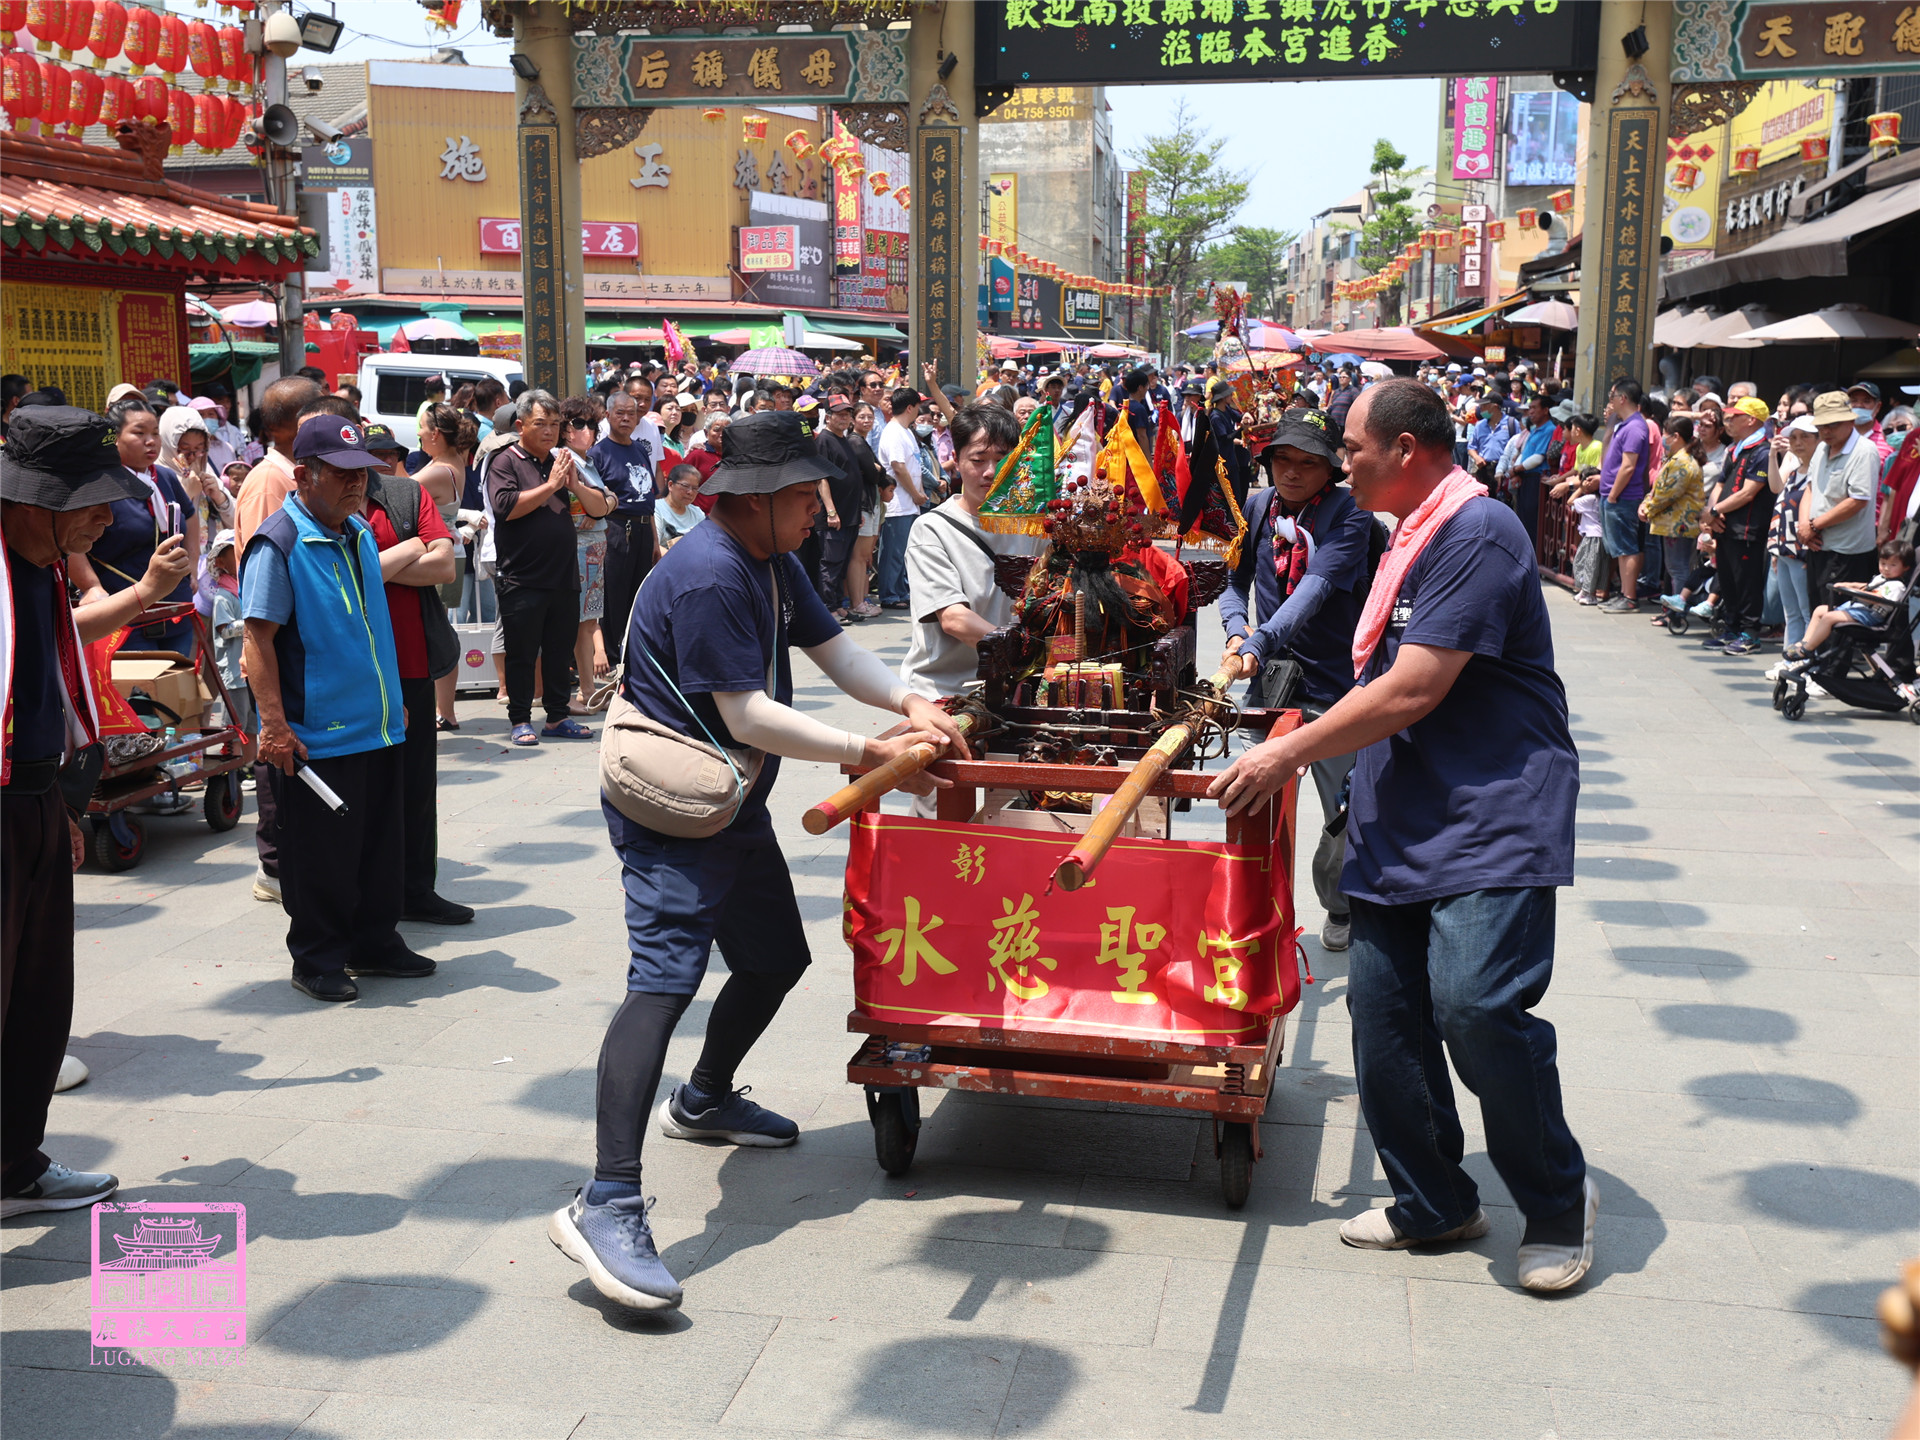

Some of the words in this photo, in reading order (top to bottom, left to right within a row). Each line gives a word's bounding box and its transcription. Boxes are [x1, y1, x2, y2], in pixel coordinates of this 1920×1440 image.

[1160, 24, 1398, 67] 蒞臨本宮進香
[1003, 105, 1075, 120] 04-758-9501
[836, 241, 860, 255] 百年老店
[873, 892, 1260, 1010] 水慈聖宮
